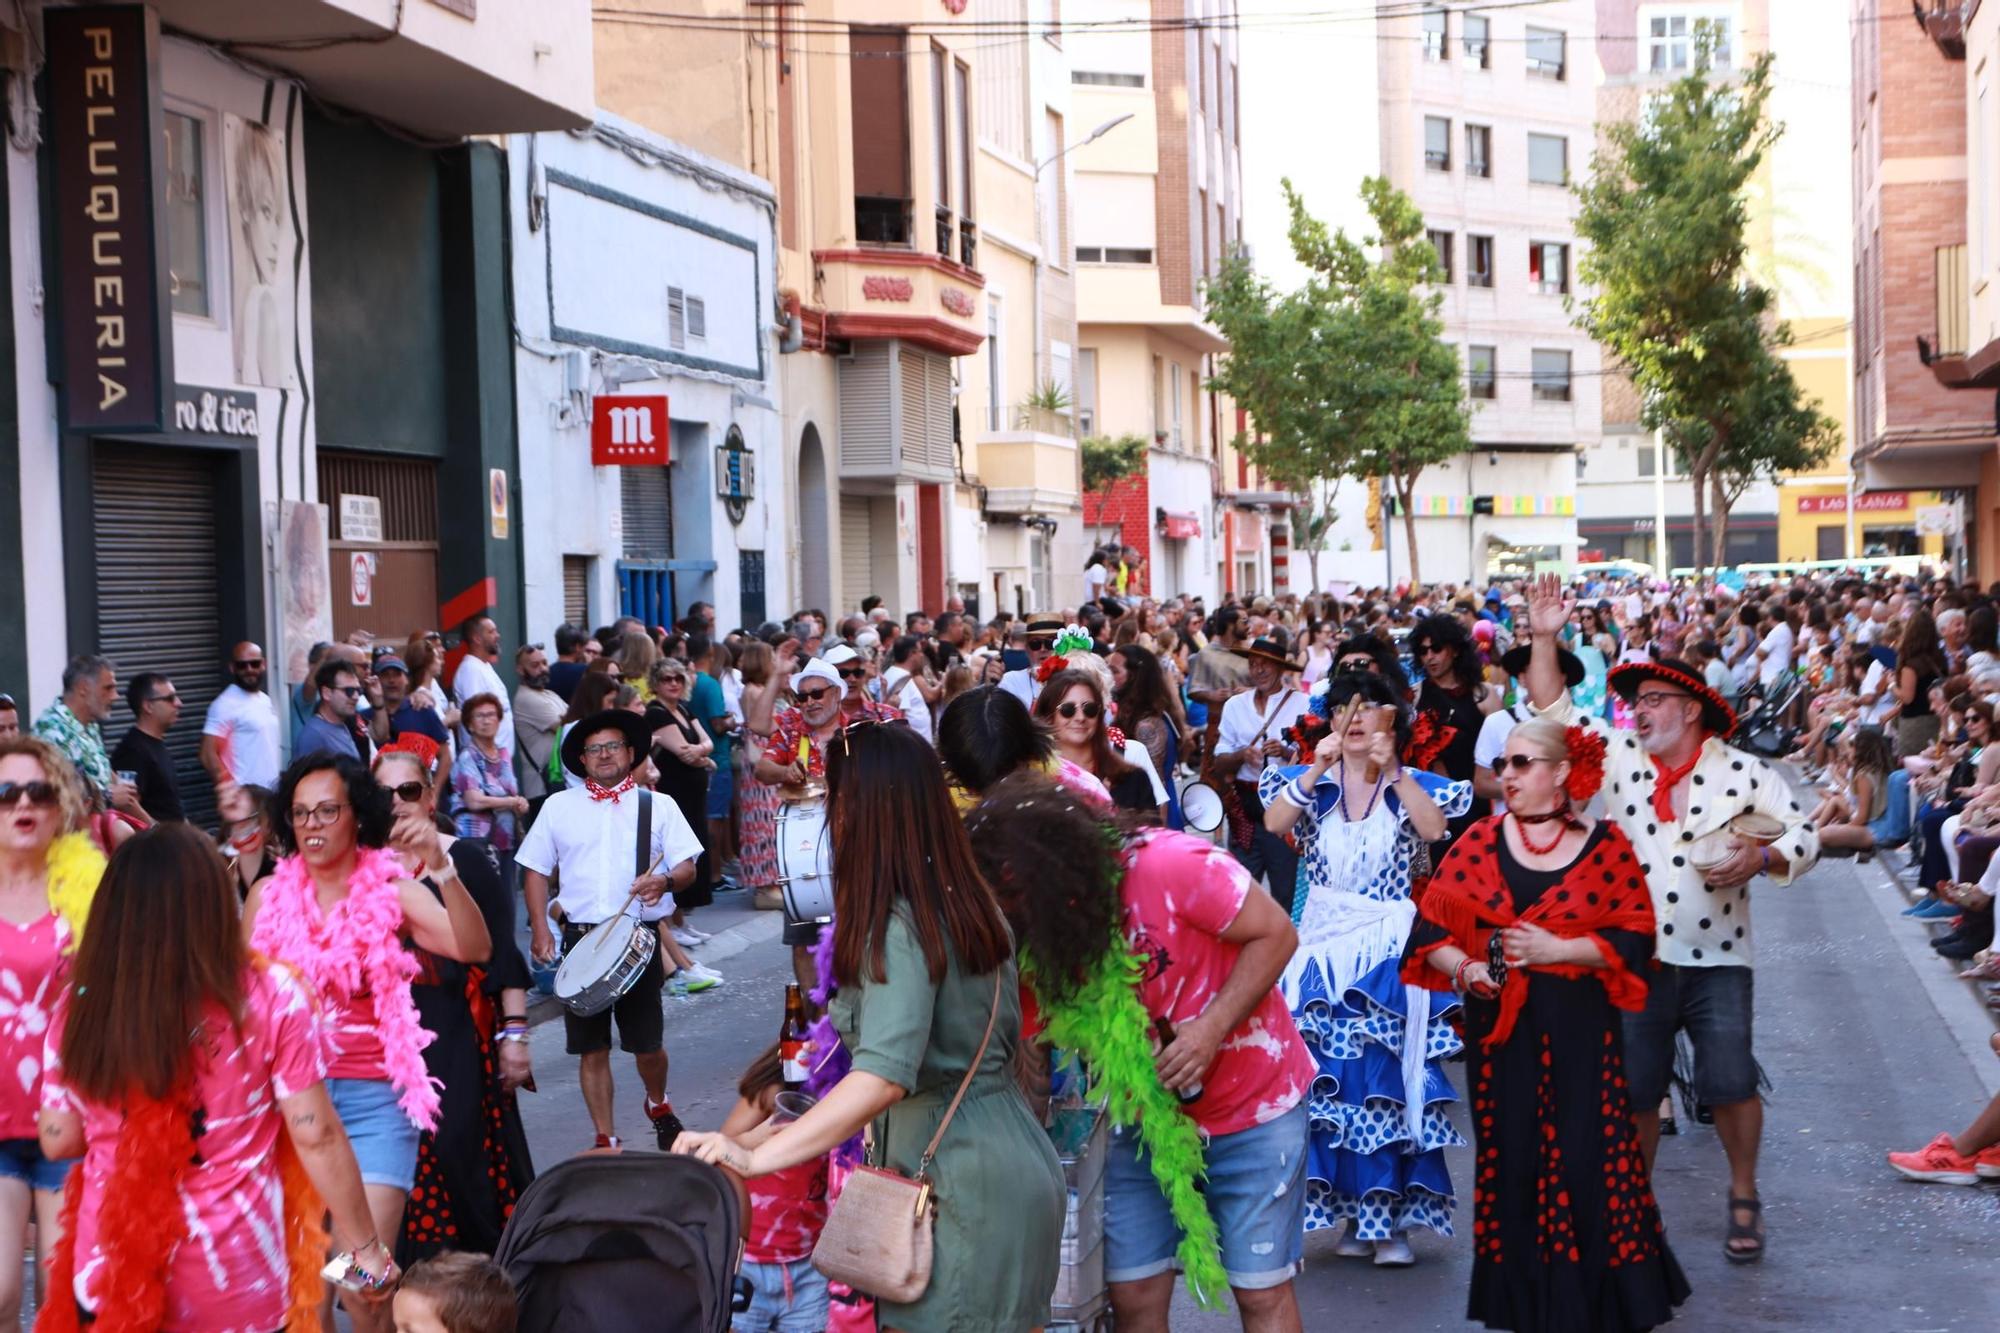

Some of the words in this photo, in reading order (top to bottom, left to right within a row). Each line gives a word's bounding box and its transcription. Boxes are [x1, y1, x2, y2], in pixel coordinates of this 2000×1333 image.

[83, 27, 128, 411] PELUQUERIA
[200, 391, 219, 433] &
[220, 395, 259, 437] tica
[607, 406, 655, 445] m
